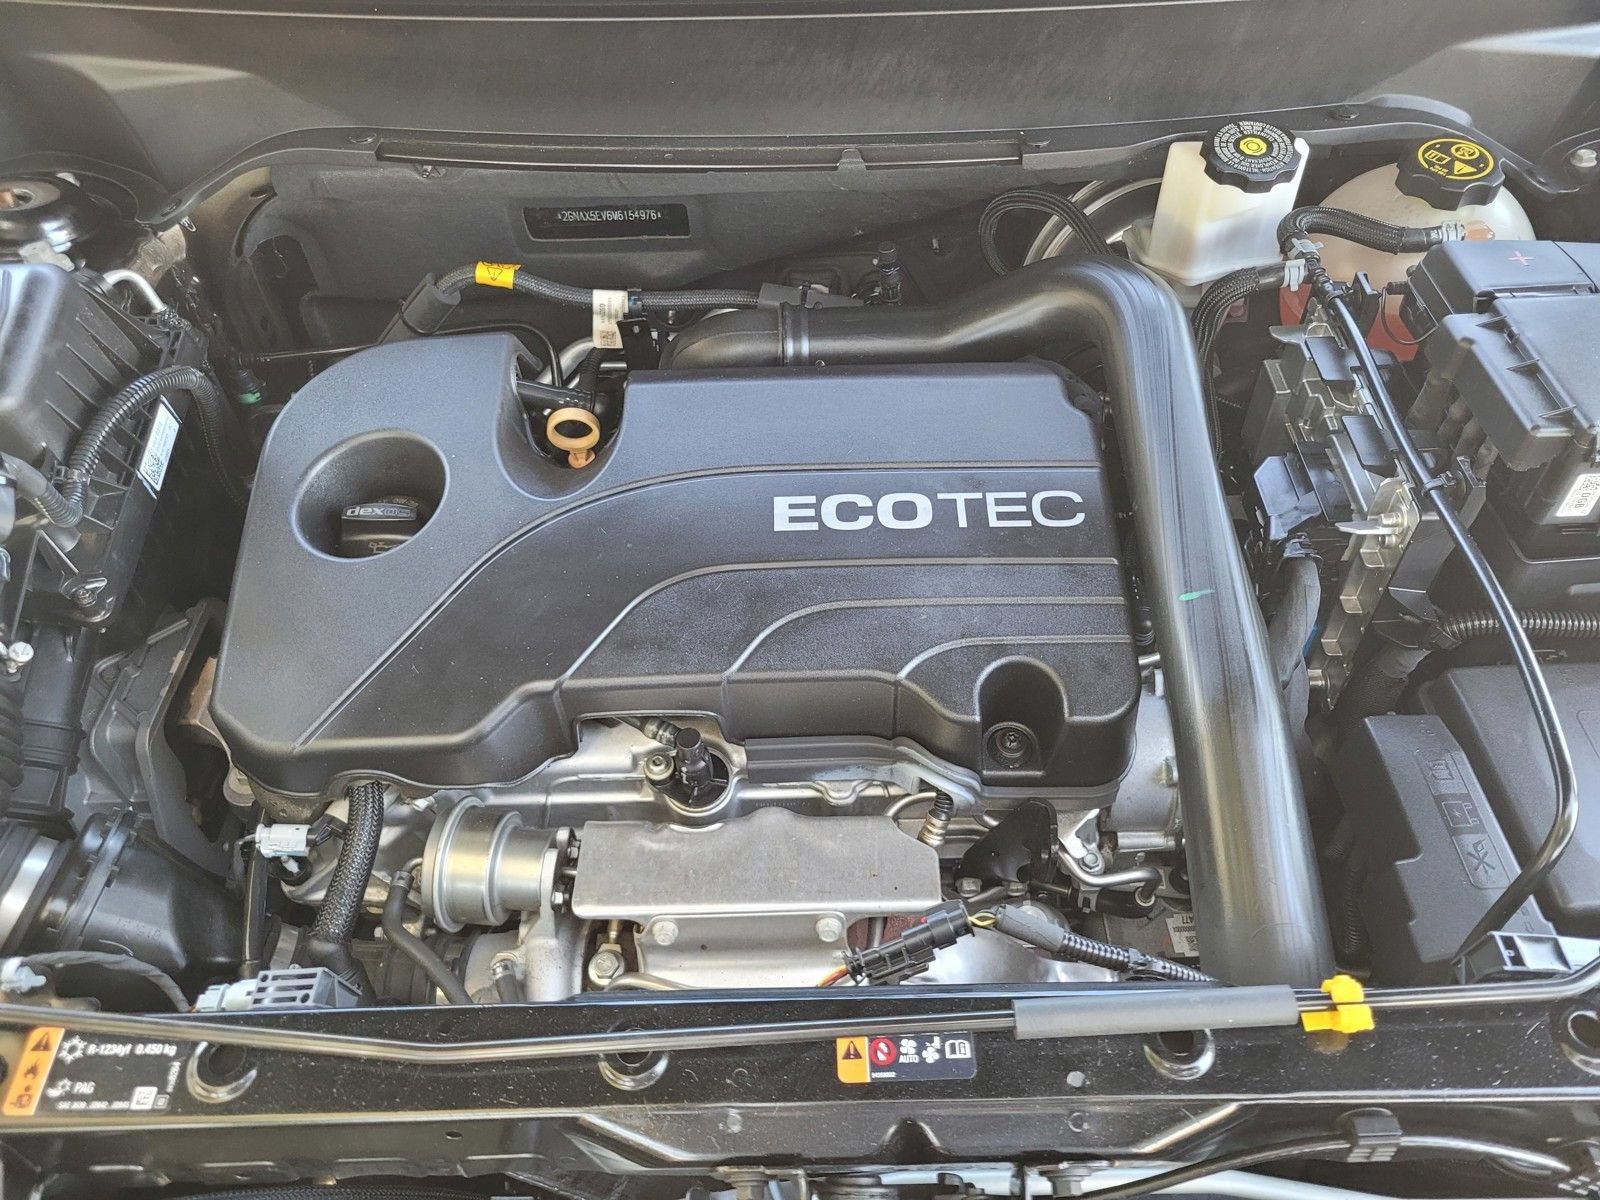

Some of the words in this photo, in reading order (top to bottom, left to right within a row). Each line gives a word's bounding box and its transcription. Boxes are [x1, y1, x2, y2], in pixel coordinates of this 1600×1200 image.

[346, 506, 411, 517] dexos
[773, 490, 1086, 532] ECOTEC
[135, 1043, 163, 1056] 0.450
[164, 1044, 178, 1057] kg
[898, 1054, 919, 1063] AUTO
[73, 1081, 96, 1094] PAG
